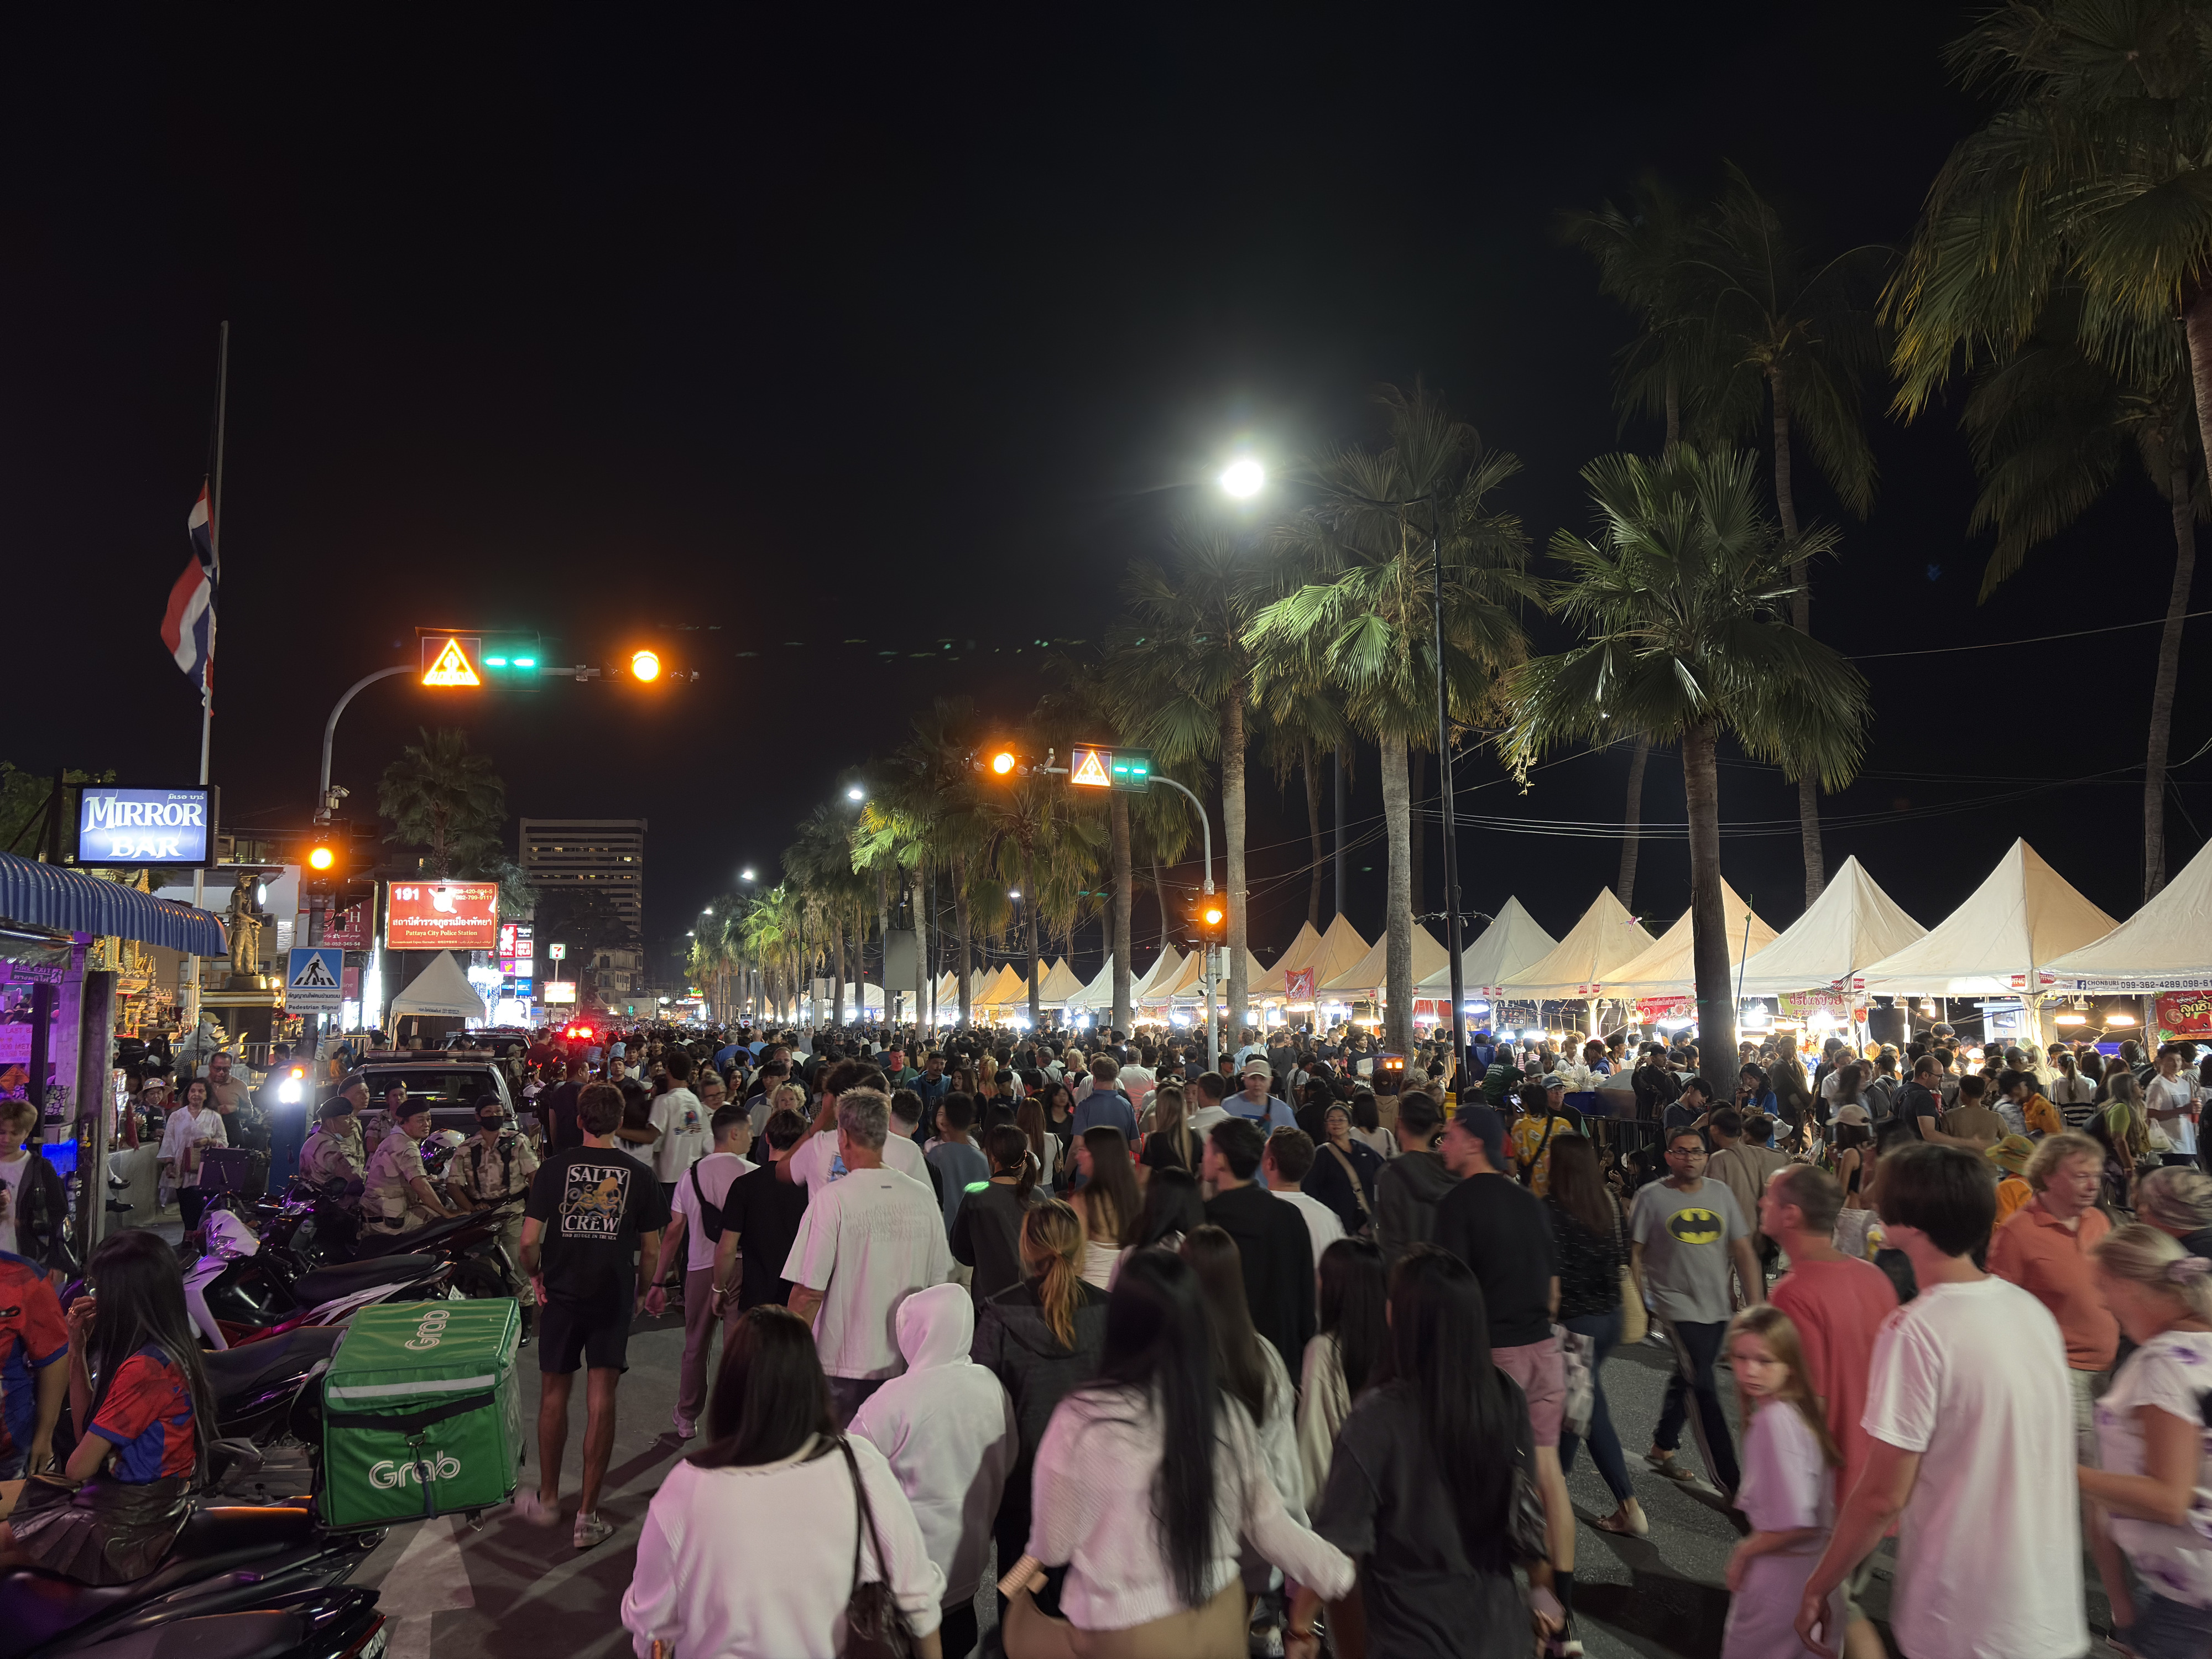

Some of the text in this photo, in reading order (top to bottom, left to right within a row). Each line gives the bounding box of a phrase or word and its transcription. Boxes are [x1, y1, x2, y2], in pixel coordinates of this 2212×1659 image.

[81, 796, 206, 833] MIRROR
[106, 836, 185, 859] BAR
[395, 888, 419, 900] 191
[569, 1167, 628, 1185] SALTY
[565, 1215, 619, 1232] CREW
[404, 1310, 450, 1350] Grab
[368, 1450, 461, 1489] Grab
